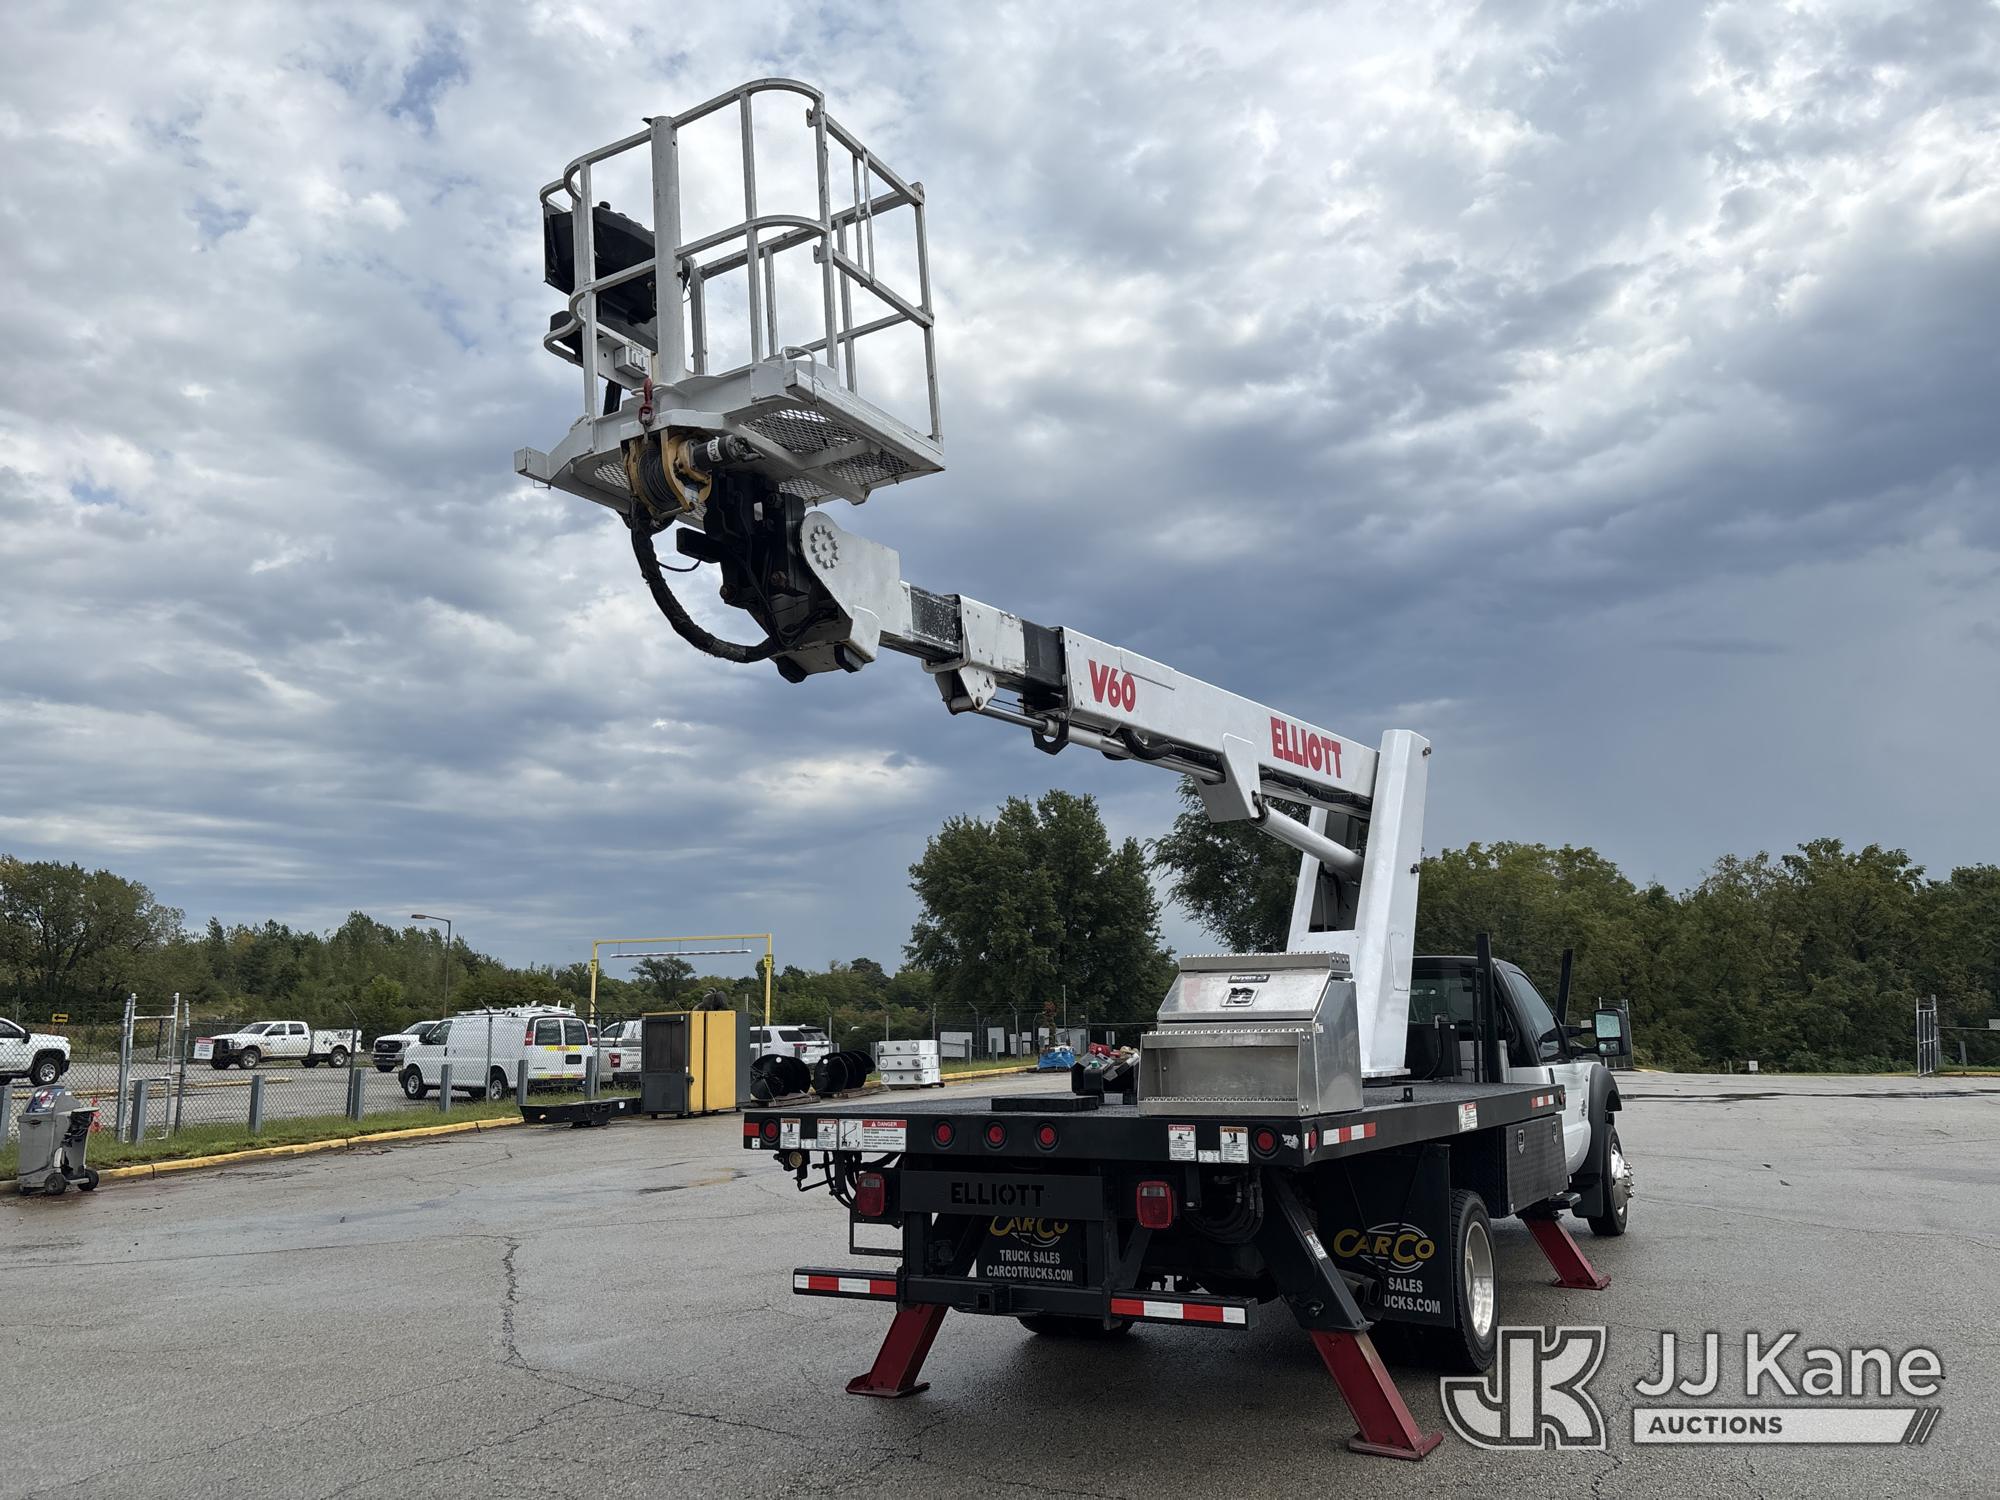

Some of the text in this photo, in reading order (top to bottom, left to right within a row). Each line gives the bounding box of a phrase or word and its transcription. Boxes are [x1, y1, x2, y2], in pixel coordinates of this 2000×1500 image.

[1088, 659, 1136, 713] V60
[1270, 716, 1342, 779] ELLIOTT
[951, 1182, 1045, 1207] ELLIOTT
[1000, 1249, 1060, 1264] TRUCK SALES
[1333, 1228, 1436, 1263] CARCO
[986, 1264, 1073, 1282] CARCOTRUCKS.COM
[1388, 1277, 1424, 1293] SALES
